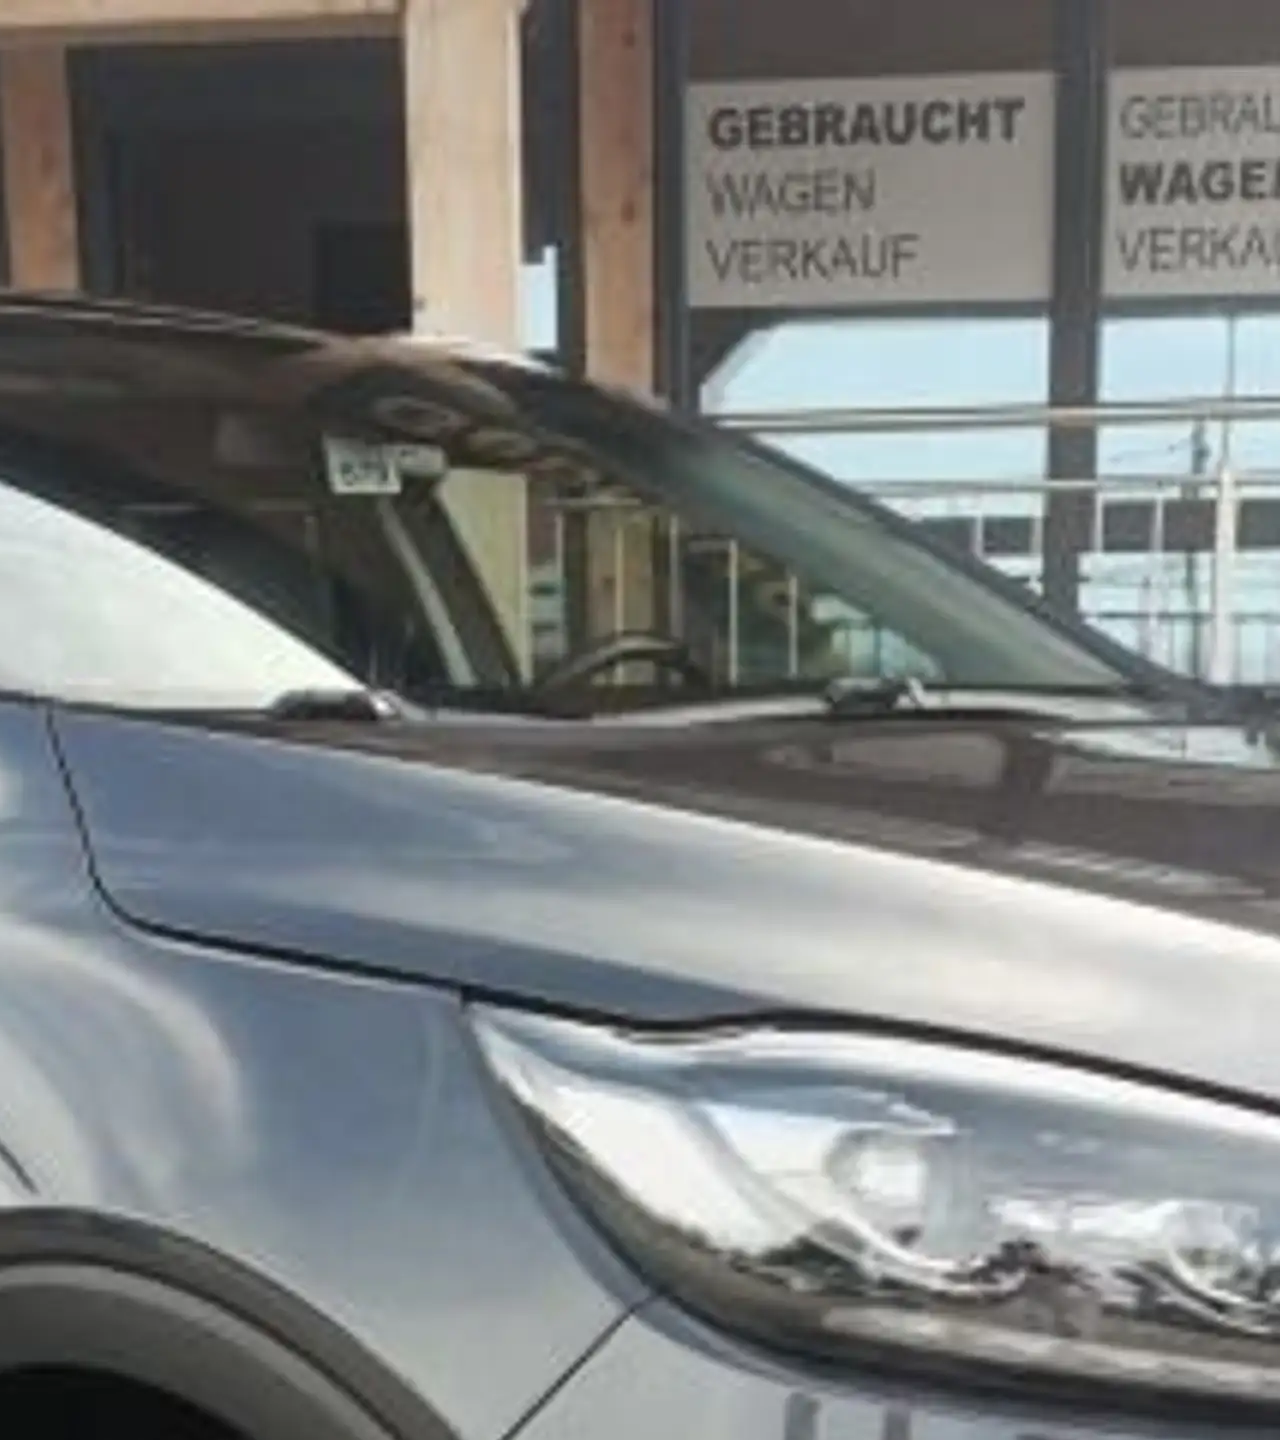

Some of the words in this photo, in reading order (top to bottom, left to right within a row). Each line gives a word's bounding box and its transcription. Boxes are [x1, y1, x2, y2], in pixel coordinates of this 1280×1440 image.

[708, 100, 1025, 148] GEBRAUCHT
[707, 168, 875, 214] WAGEN
[707, 234, 919, 282] VERKAUF
